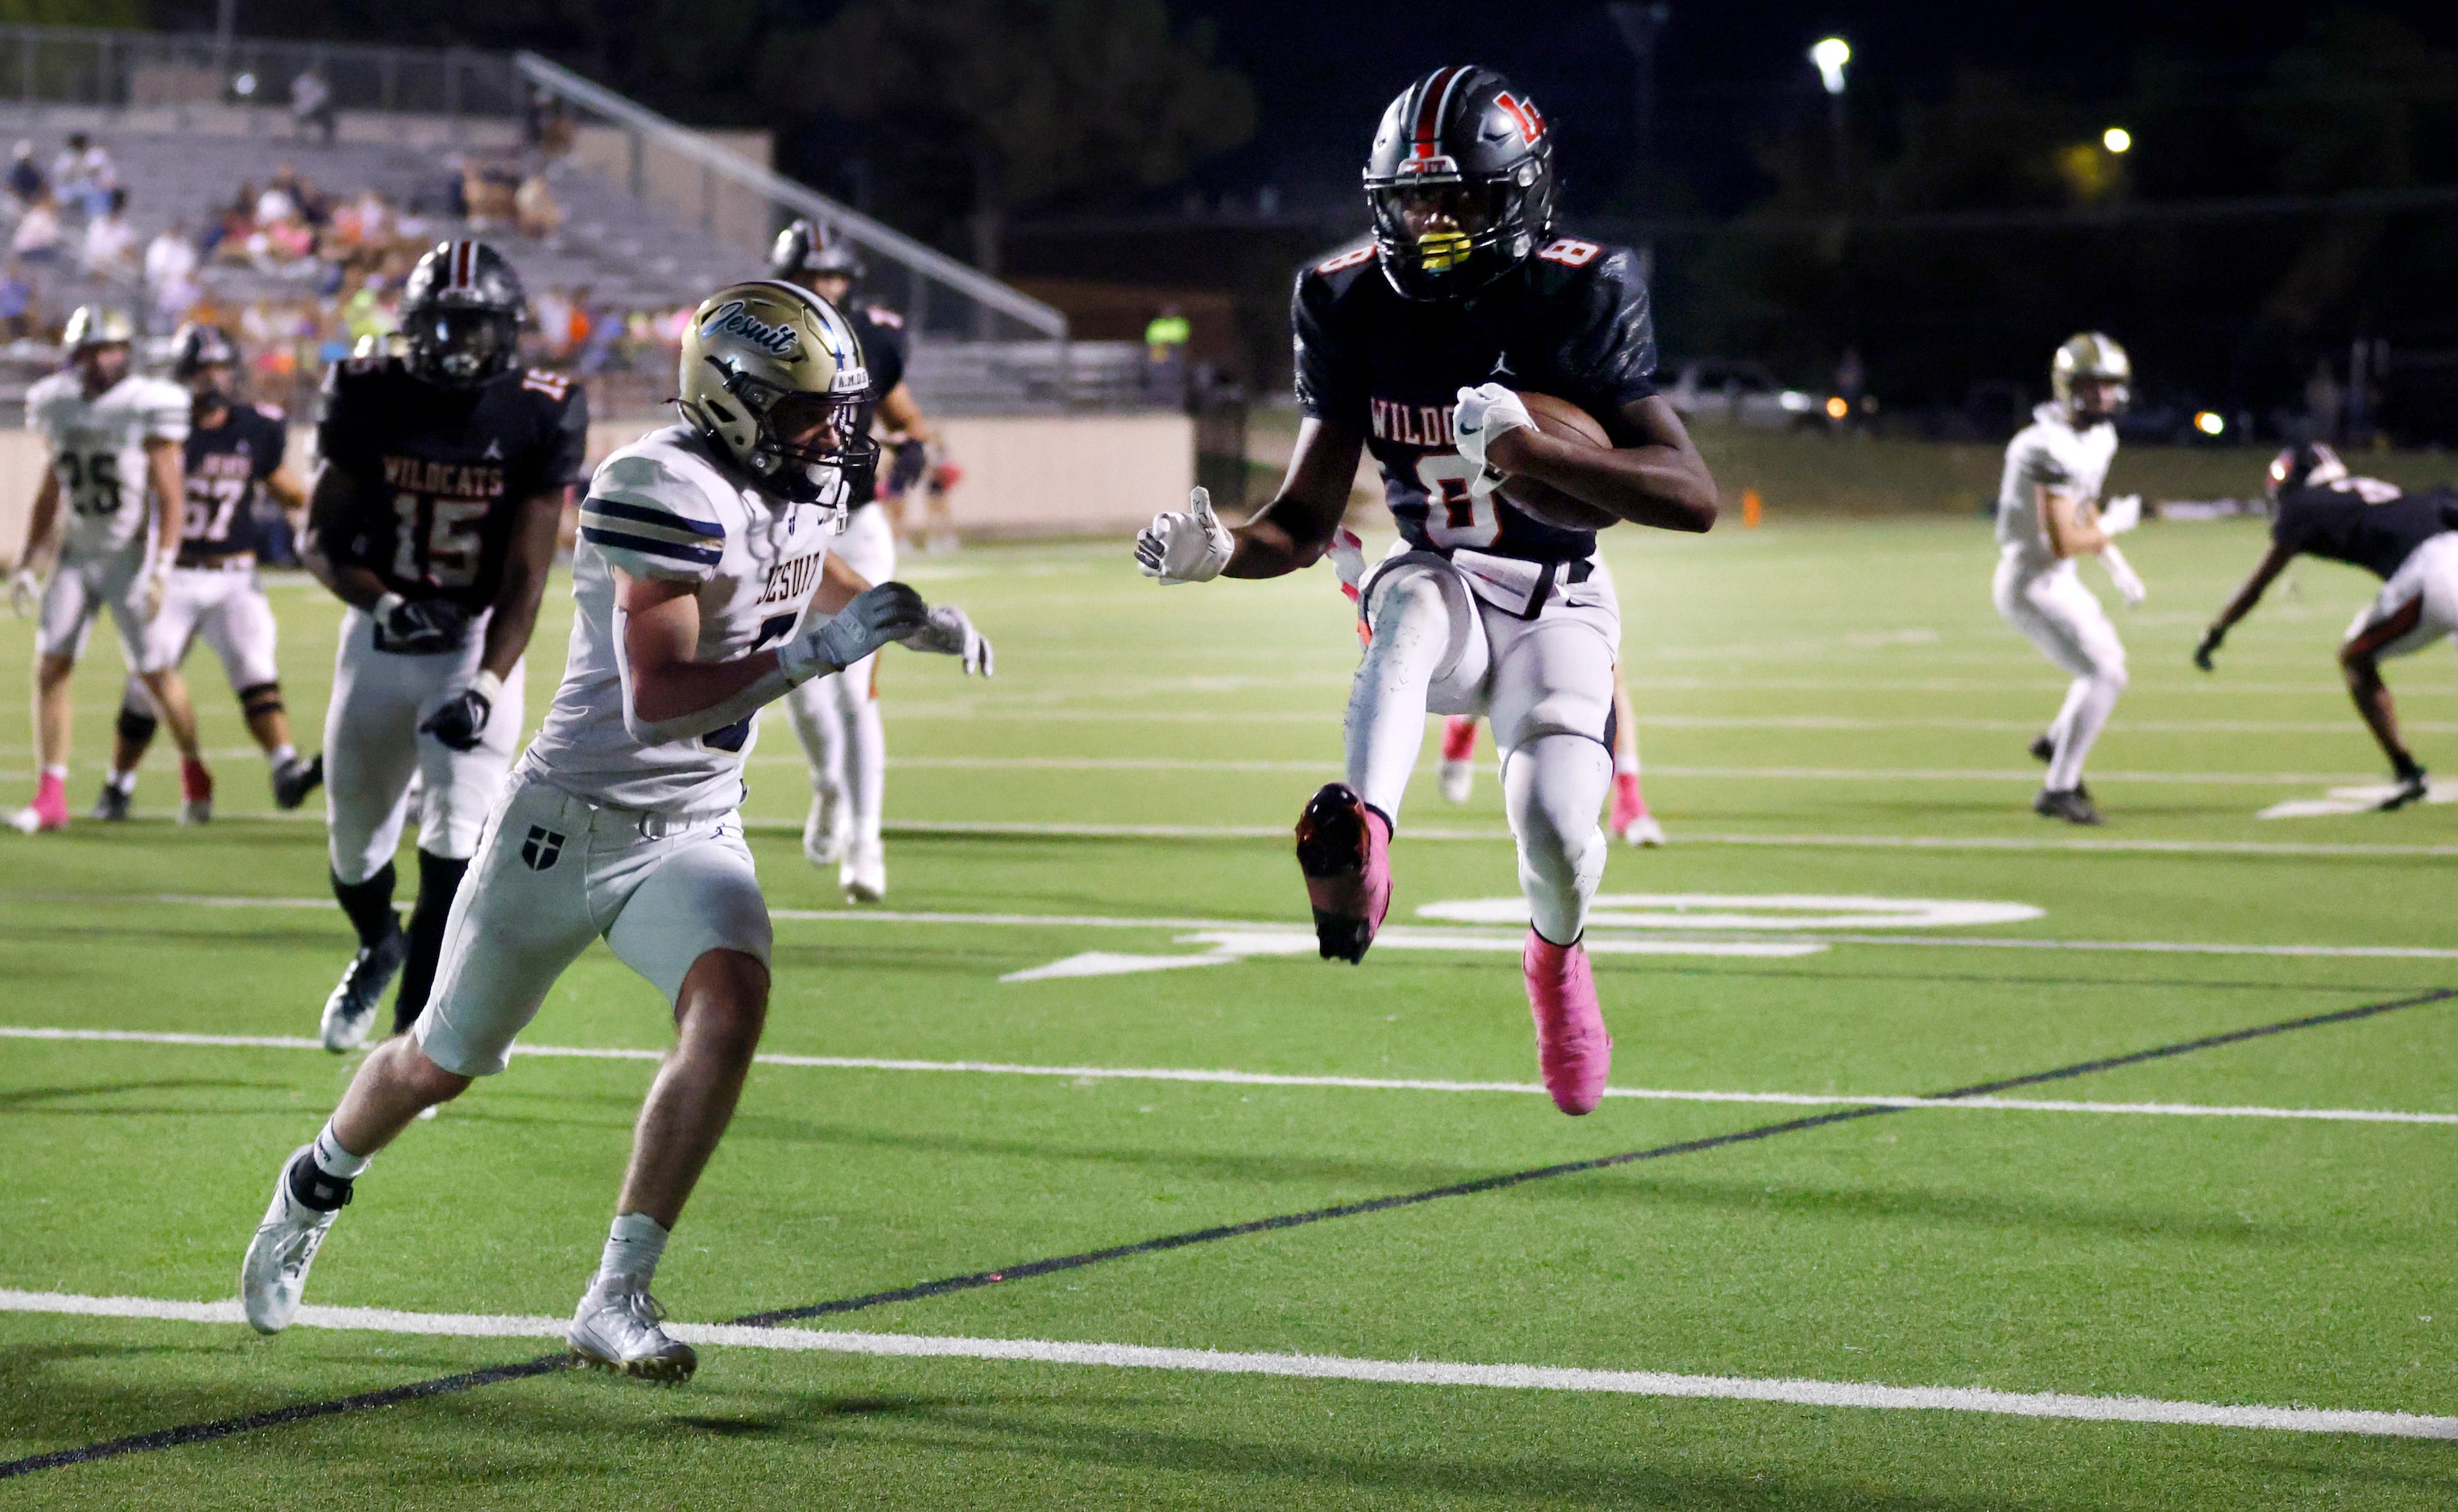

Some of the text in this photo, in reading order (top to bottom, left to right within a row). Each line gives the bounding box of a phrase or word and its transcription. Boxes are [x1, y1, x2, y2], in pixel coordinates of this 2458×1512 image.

[1537, 238, 1602, 268] 8
[700, 301, 799, 356] Jesuit
[383, 455, 506, 497] WILDCATS
[1413, 453, 1502, 548] 8
[391, 492, 492, 589] 15
[755, 551, 821, 605] JESUIT
